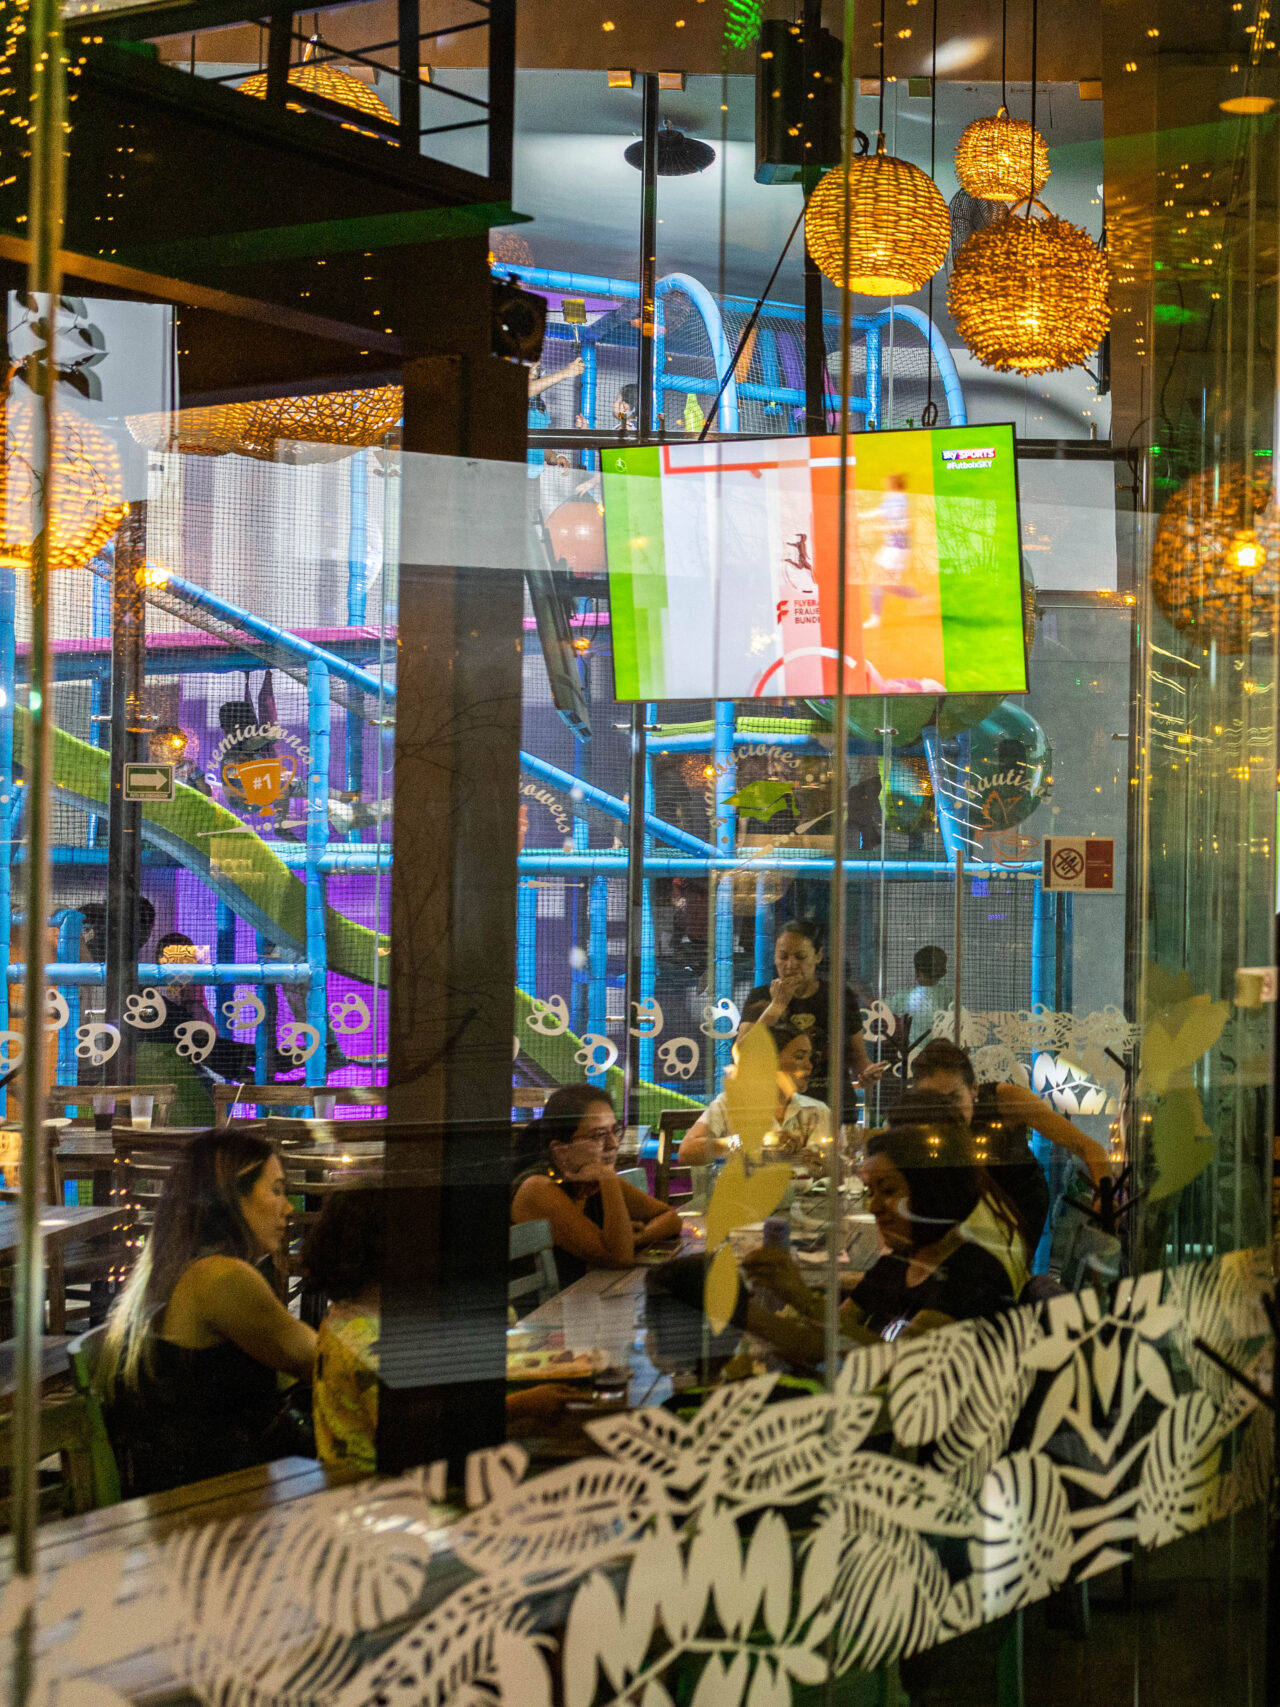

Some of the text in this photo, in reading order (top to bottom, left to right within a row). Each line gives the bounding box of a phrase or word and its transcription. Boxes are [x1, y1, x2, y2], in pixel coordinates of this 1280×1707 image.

[958, 448, 995, 459] SPORTS
[205, 721, 315, 787] premiaciones
[252, 773, 272, 790] #1
